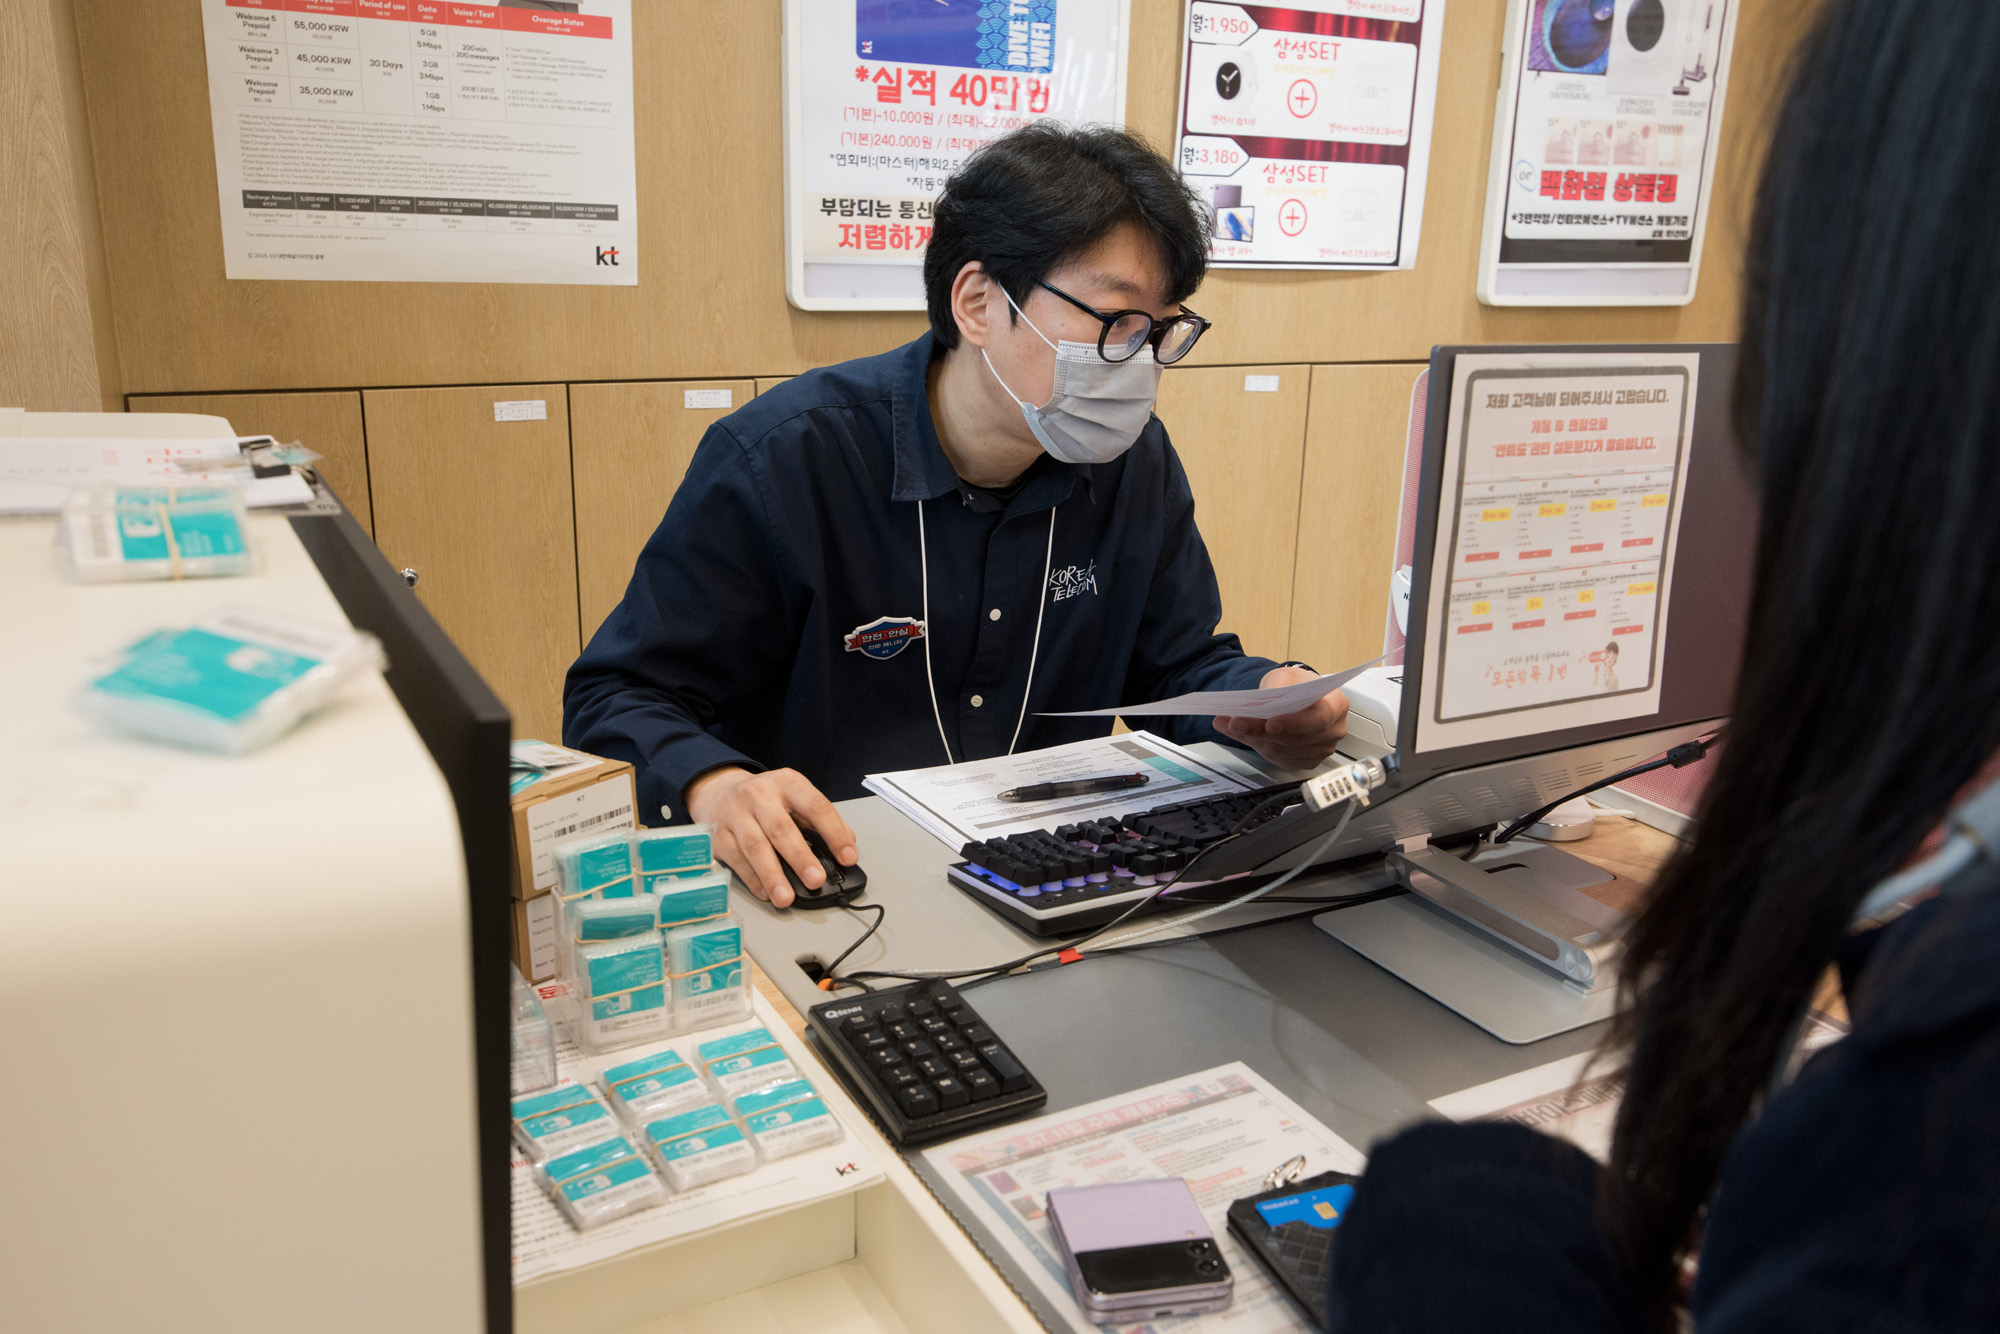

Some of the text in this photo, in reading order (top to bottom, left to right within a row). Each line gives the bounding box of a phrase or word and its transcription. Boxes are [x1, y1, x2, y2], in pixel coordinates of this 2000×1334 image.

[360, 0, 382, 8] Period
[418, 4, 437, 13] Data
[236, 12, 270, 21] Welcome
[453, 8, 472, 18] Voice
[479, 10, 495, 19] Text
[243, 21, 271, 30] Prepaid
[294, 21, 349, 32] 55,000 KRW
[532, 15, 584, 27] Overage Rates
[422, 42, 442, 50] Mbps
[862, 40, 872, 53] kt
[1008, 20, 1029, 66] DIVE
[1030, 22, 1051, 67] WIFI
[239, 45, 272, 55] Welcome
[1274, 38, 1341, 61] 삼성SET
[246, 54, 272, 63] Prepaid
[297, 54, 351, 65] 45,000 KRW
[383, 60, 403, 70] Days
[425, 72, 444, 82] Mbps
[244, 79, 278, 88] Welcome
[249, 87, 275, 96] Prepaid
[299, 87, 331, 96] 35,000
[950, 74, 1050, 113] 40만원
[426, 104, 445, 112] Mbps
[1263, 163, 1329, 184] 삼성SET
[1519, 172, 1533, 181] or
[820, 198, 892, 218] 부담되는
[596, 246, 619, 266] kt
[1486, 389, 1669, 409] 저희 고객님이 되어주셔서 고맙습니다.
[1554, 419, 1564, 432] 후
[1049, 559, 1096, 587] KOREA
[1050, 575, 1098, 602] TELECOM
[1025, 1131, 1048, 1148] KT
